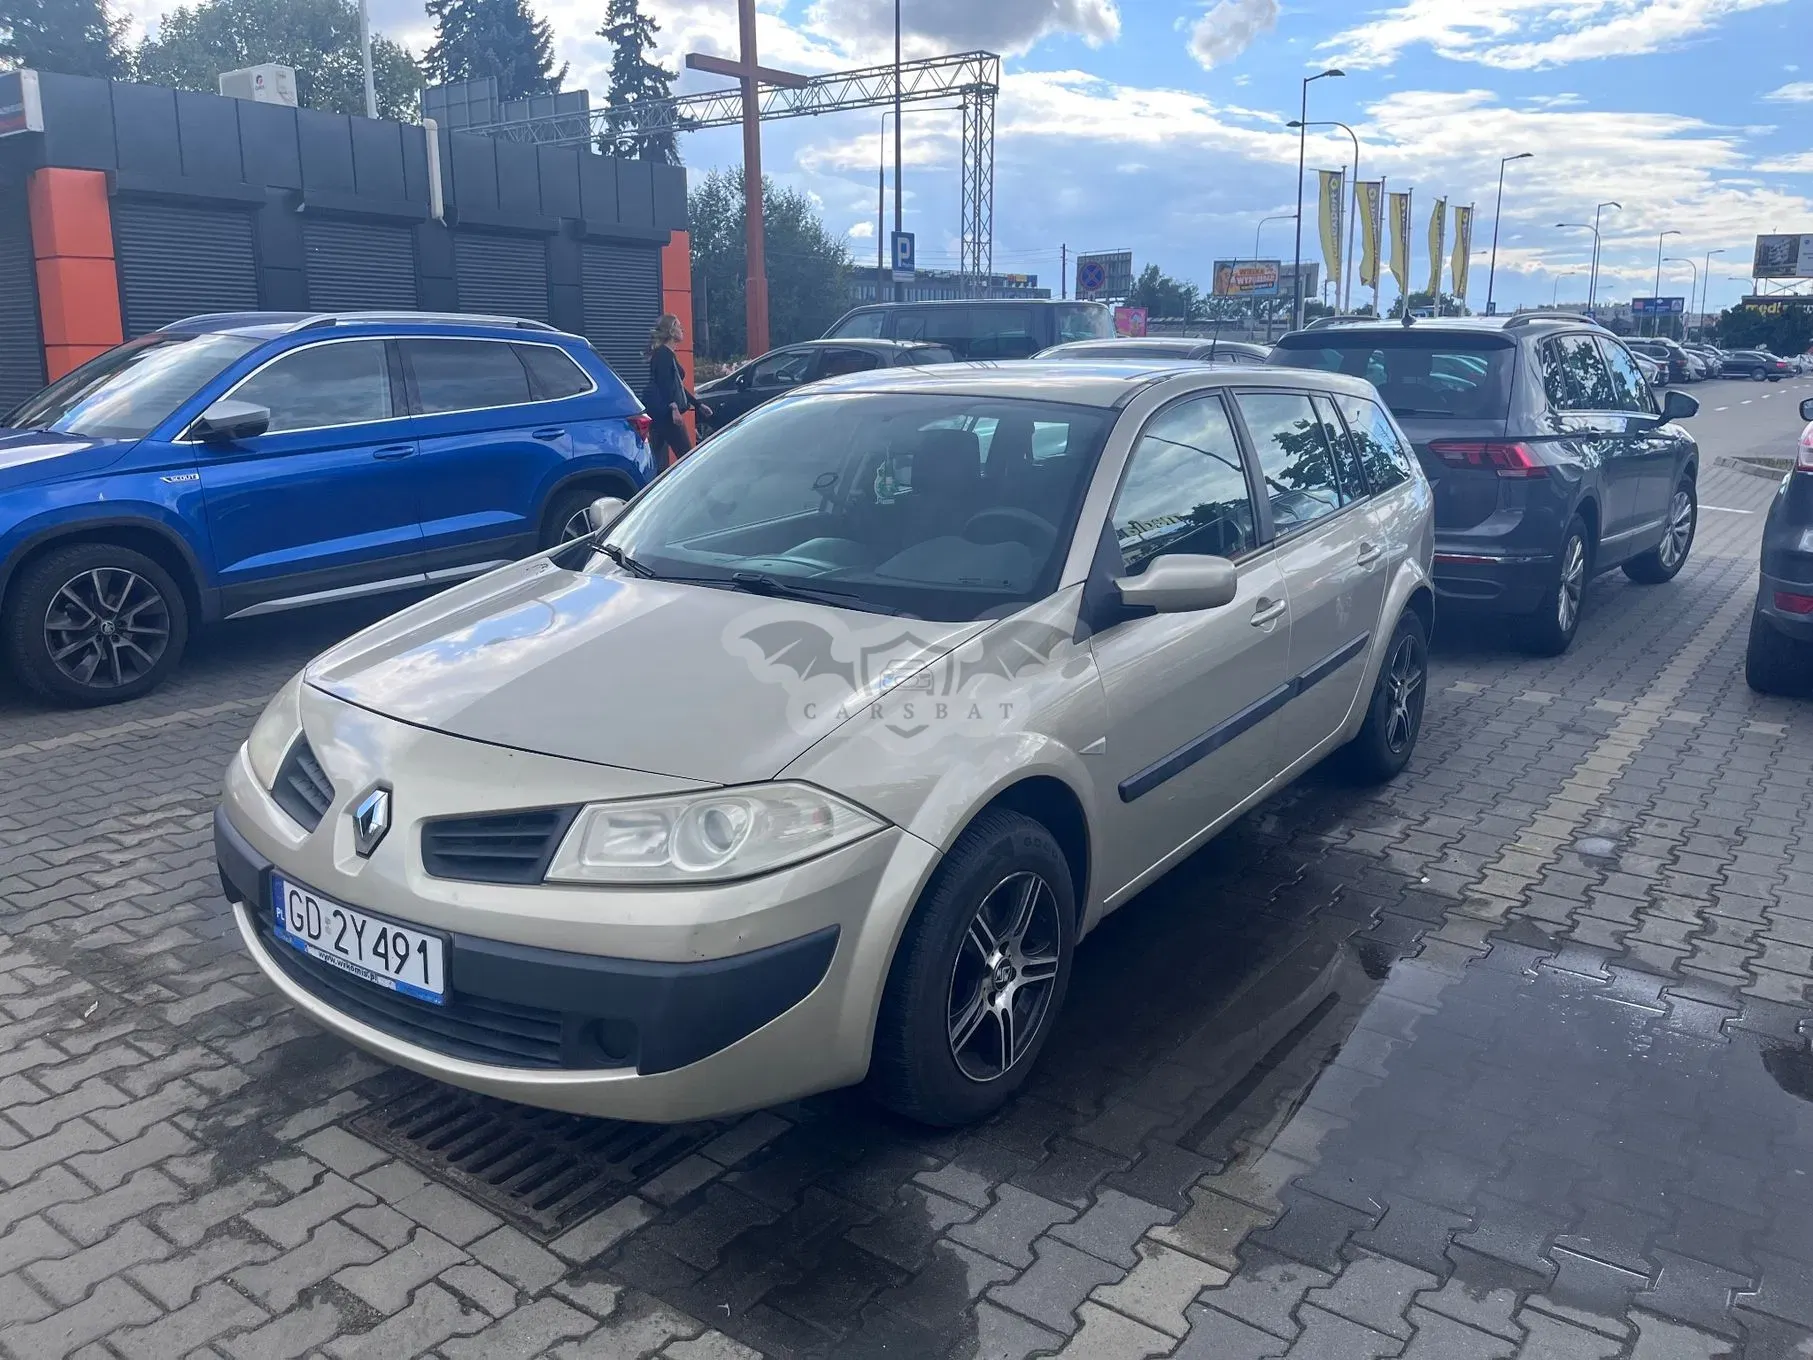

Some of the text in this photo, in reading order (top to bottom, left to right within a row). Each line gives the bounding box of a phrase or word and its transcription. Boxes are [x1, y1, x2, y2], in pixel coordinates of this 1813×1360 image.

[897, 237, 911, 267] P
[276, 907, 285, 921] PL
[289, 889, 429, 985] GD 2Y491
